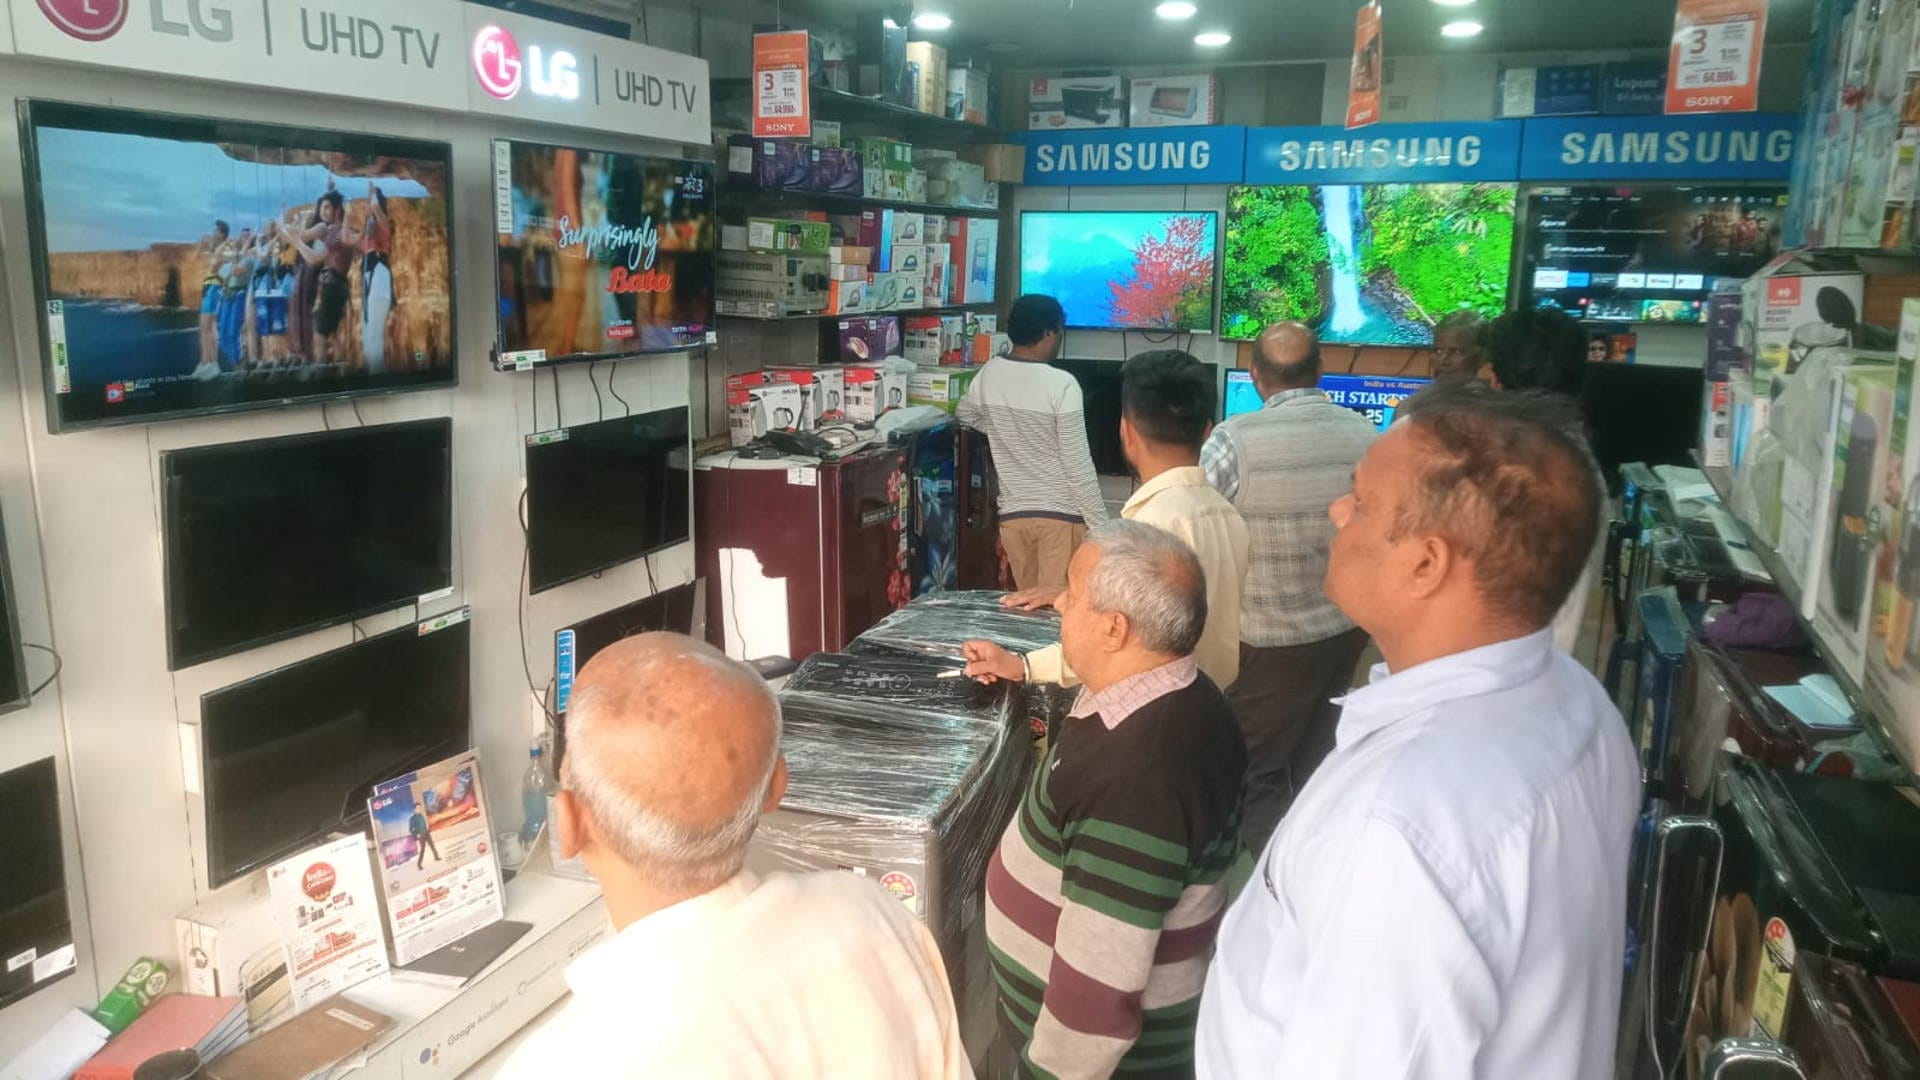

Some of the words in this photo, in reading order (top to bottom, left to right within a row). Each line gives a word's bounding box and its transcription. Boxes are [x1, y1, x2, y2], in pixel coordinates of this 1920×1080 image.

[301, 7, 384, 59] UHD
[391, 25, 440, 69] TV
[1689, 28, 1708, 54] 3
[528, 44, 580, 100] LG
[615, 68, 663, 107] UHD
[667, 81, 697, 113] TV
[764, 73, 775, 91] 3
[1685, 96, 1734, 107] SONY
[766, 123, 795, 132] SONY
[1036, 141, 1210, 172] SAMSUNG
[1280, 136, 1481, 171] SAMSUNG
[1562, 130, 1793, 164] SAMSUNG
[559, 215, 660, 270] Surprisingly
[607, 265, 673, 294] Bata
[447, 1021, 477, 1046] Google
